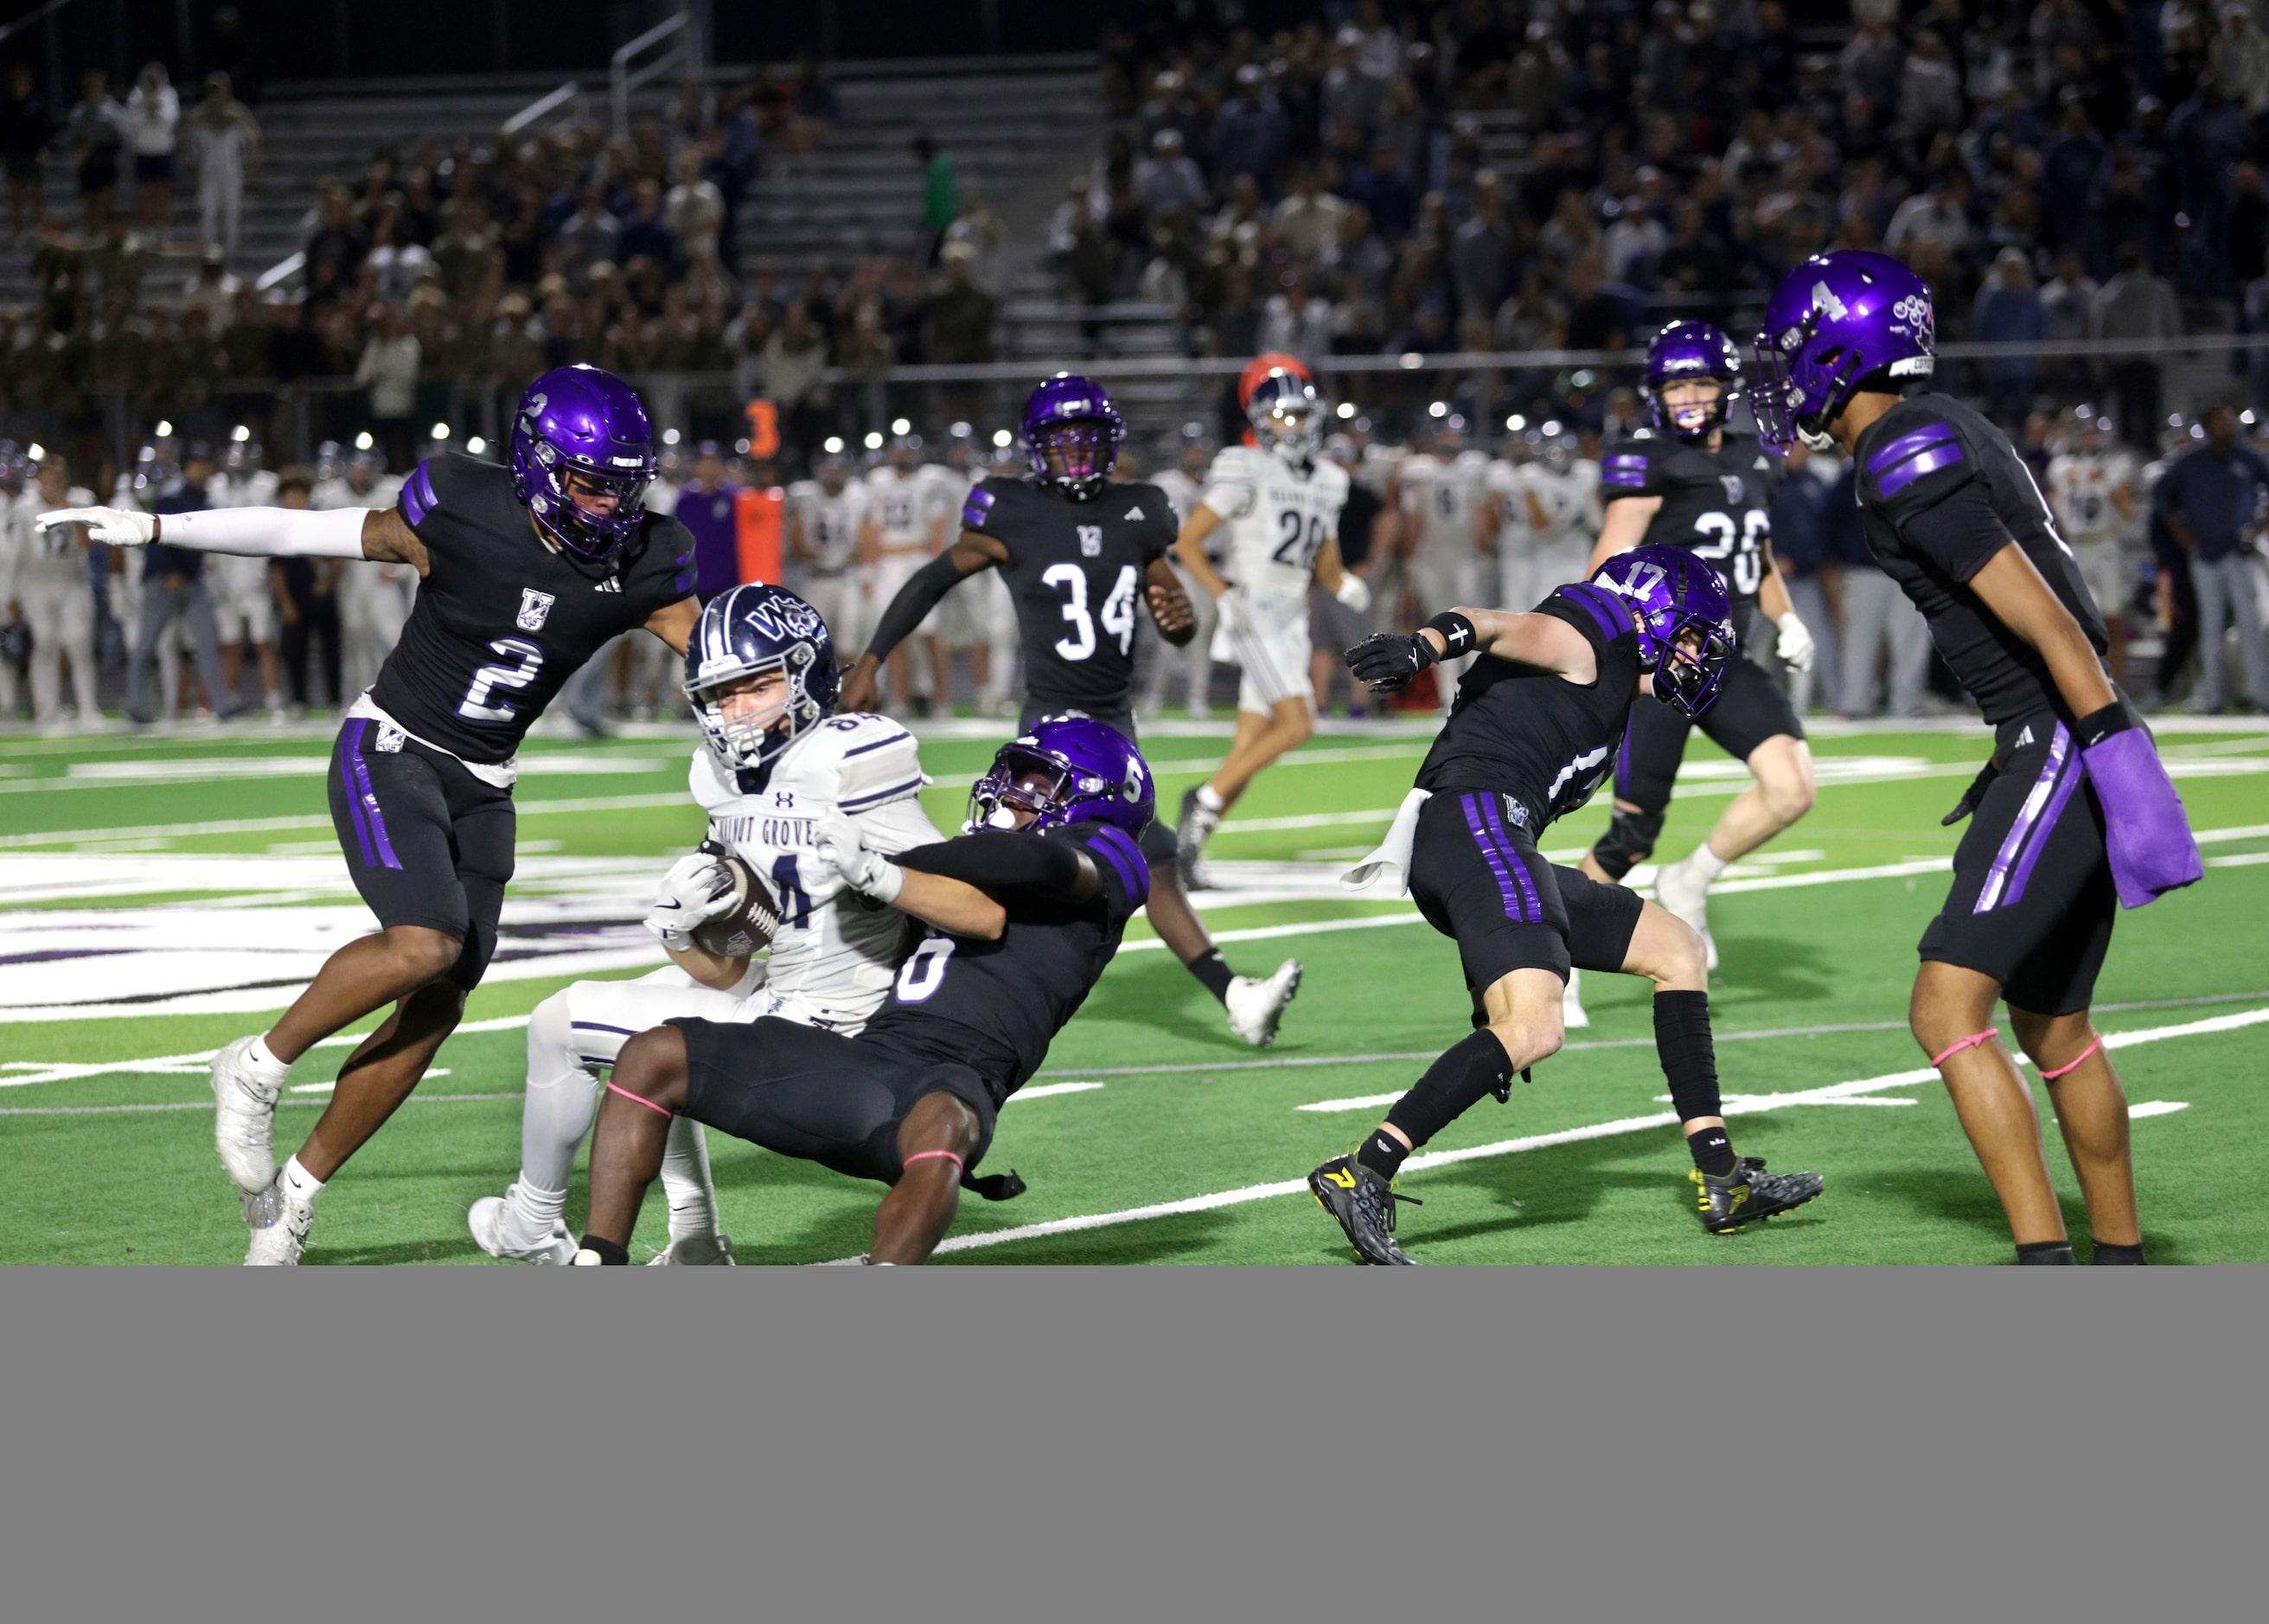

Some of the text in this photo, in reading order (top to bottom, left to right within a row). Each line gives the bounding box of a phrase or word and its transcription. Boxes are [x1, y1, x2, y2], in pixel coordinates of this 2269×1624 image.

[1812, 280, 1848, 323] 4
[520, 393, 548, 436] 2
[745, 399, 779, 460] 3
[1620, 560, 1668, 603] 17
[1042, 563, 1137, 662] 34
[455, 636, 546, 722] 2
[763, 819, 814, 847] GROVE
